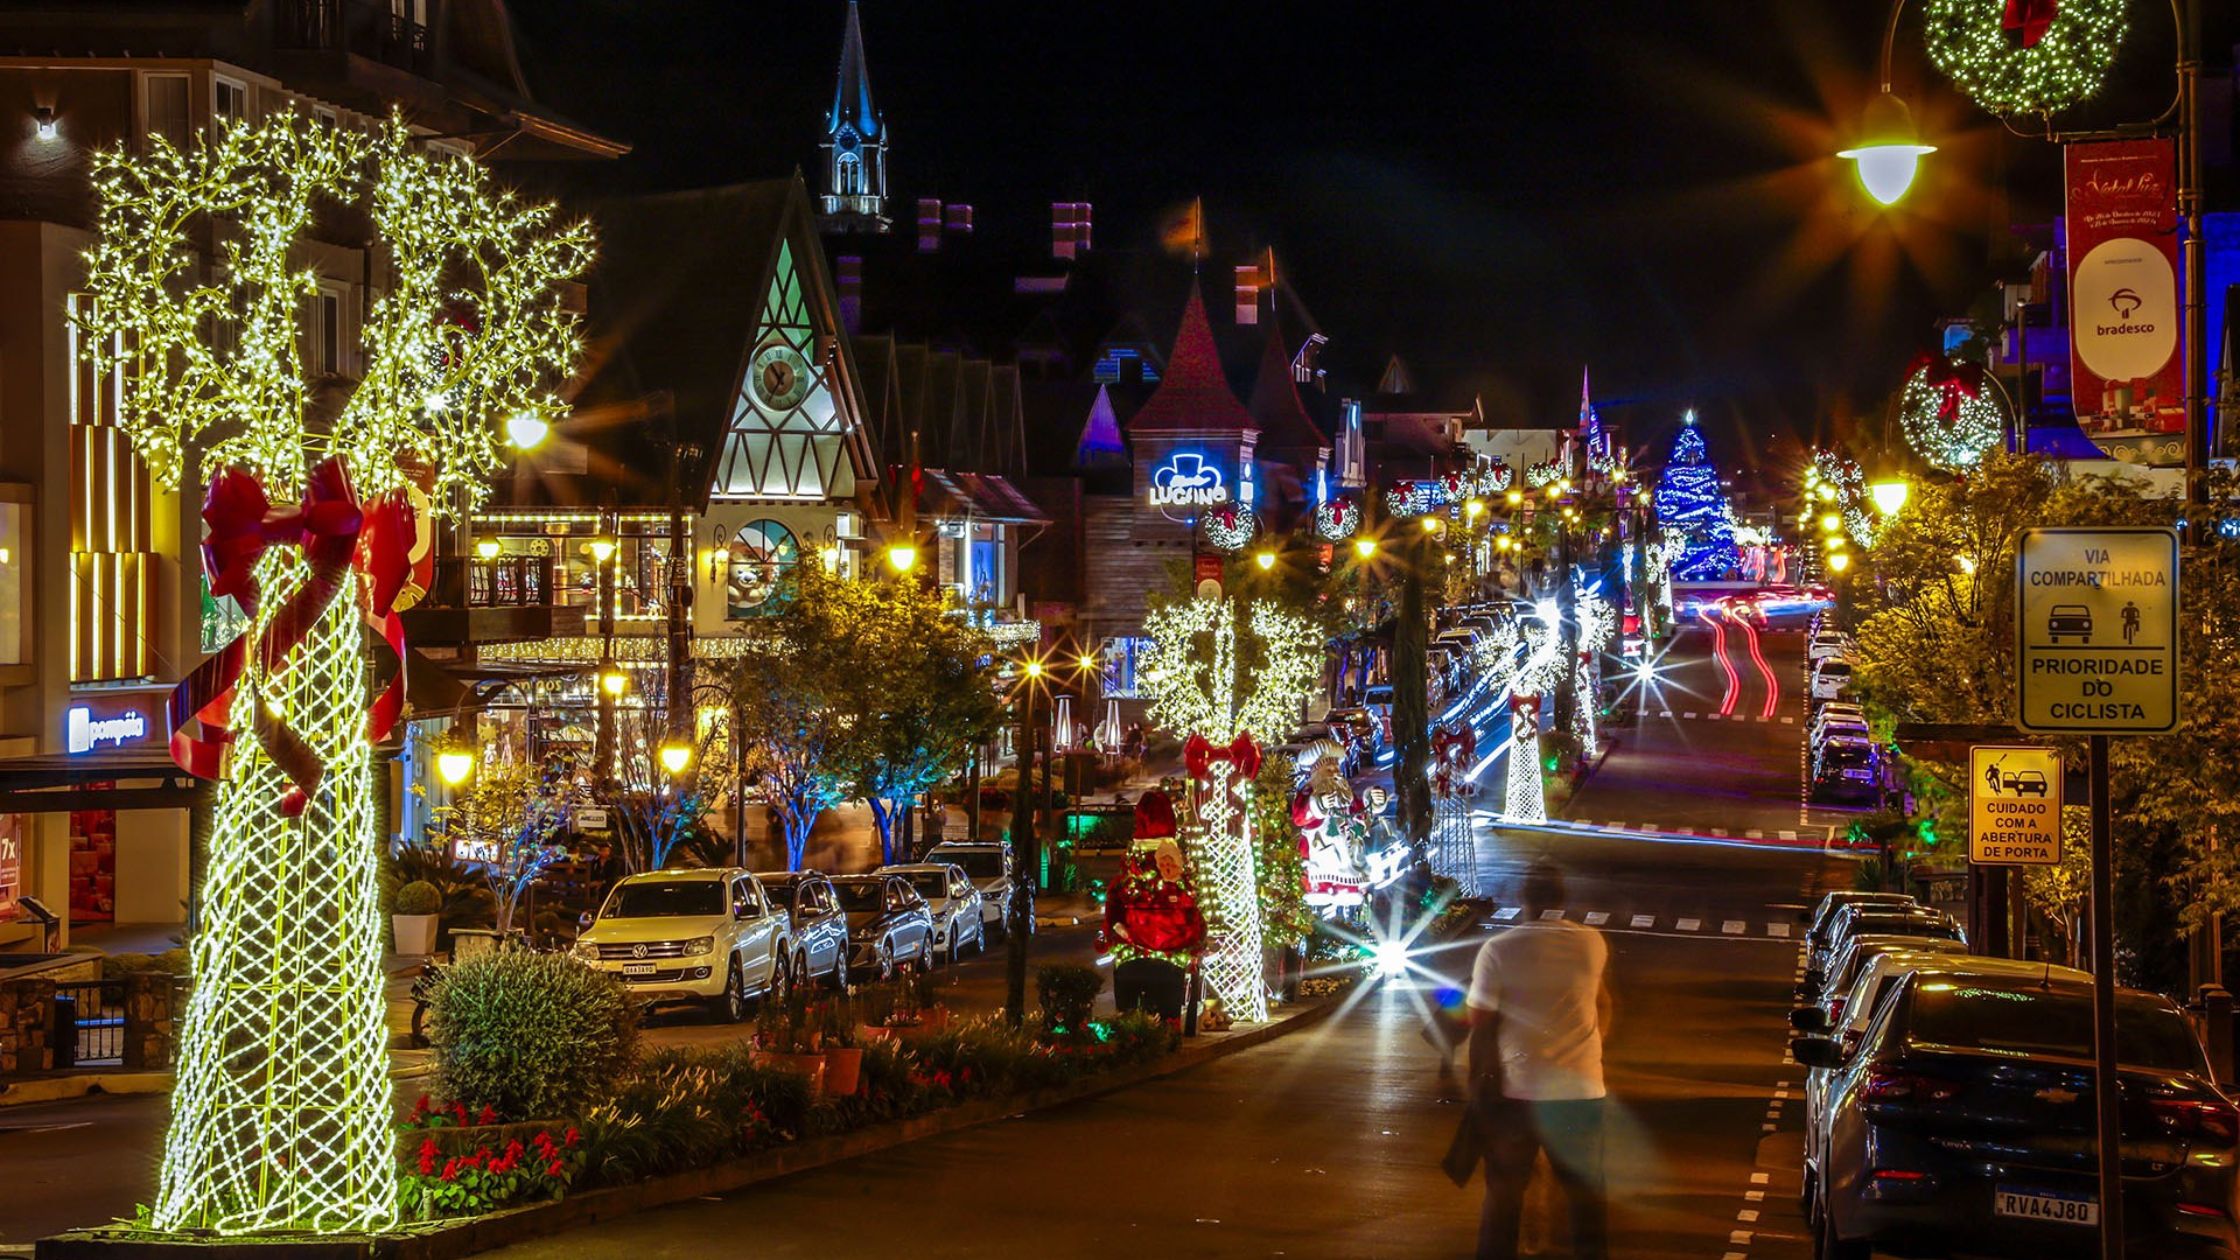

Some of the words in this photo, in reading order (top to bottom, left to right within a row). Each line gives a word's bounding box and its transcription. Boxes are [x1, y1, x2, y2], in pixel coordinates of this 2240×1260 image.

[2096, 322, 2155, 337] bradesco
[1149, 485, 1227, 506] LUGANO
[2085, 549, 2111, 564] VIA
[2031, 571, 2166, 587] COMPARTILHADA
[2032, 659, 2164, 675] PRIORIDADE
[2082, 682, 2113, 697] DO
[2050, 703, 2146, 720] CICLISTA
[1987, 803, 2046, 814] CUIDADO
[1995, 818, 2023, 828] COM
[2027, 818, 2037, 828] A
[1980, 832, 2051, 843] ABERTURA
[1983, 846, 2001, 858] DE
[2004, 846, 2048, 858] PORTA
[2005, 1194, 2089, 1222] RVA4J80
